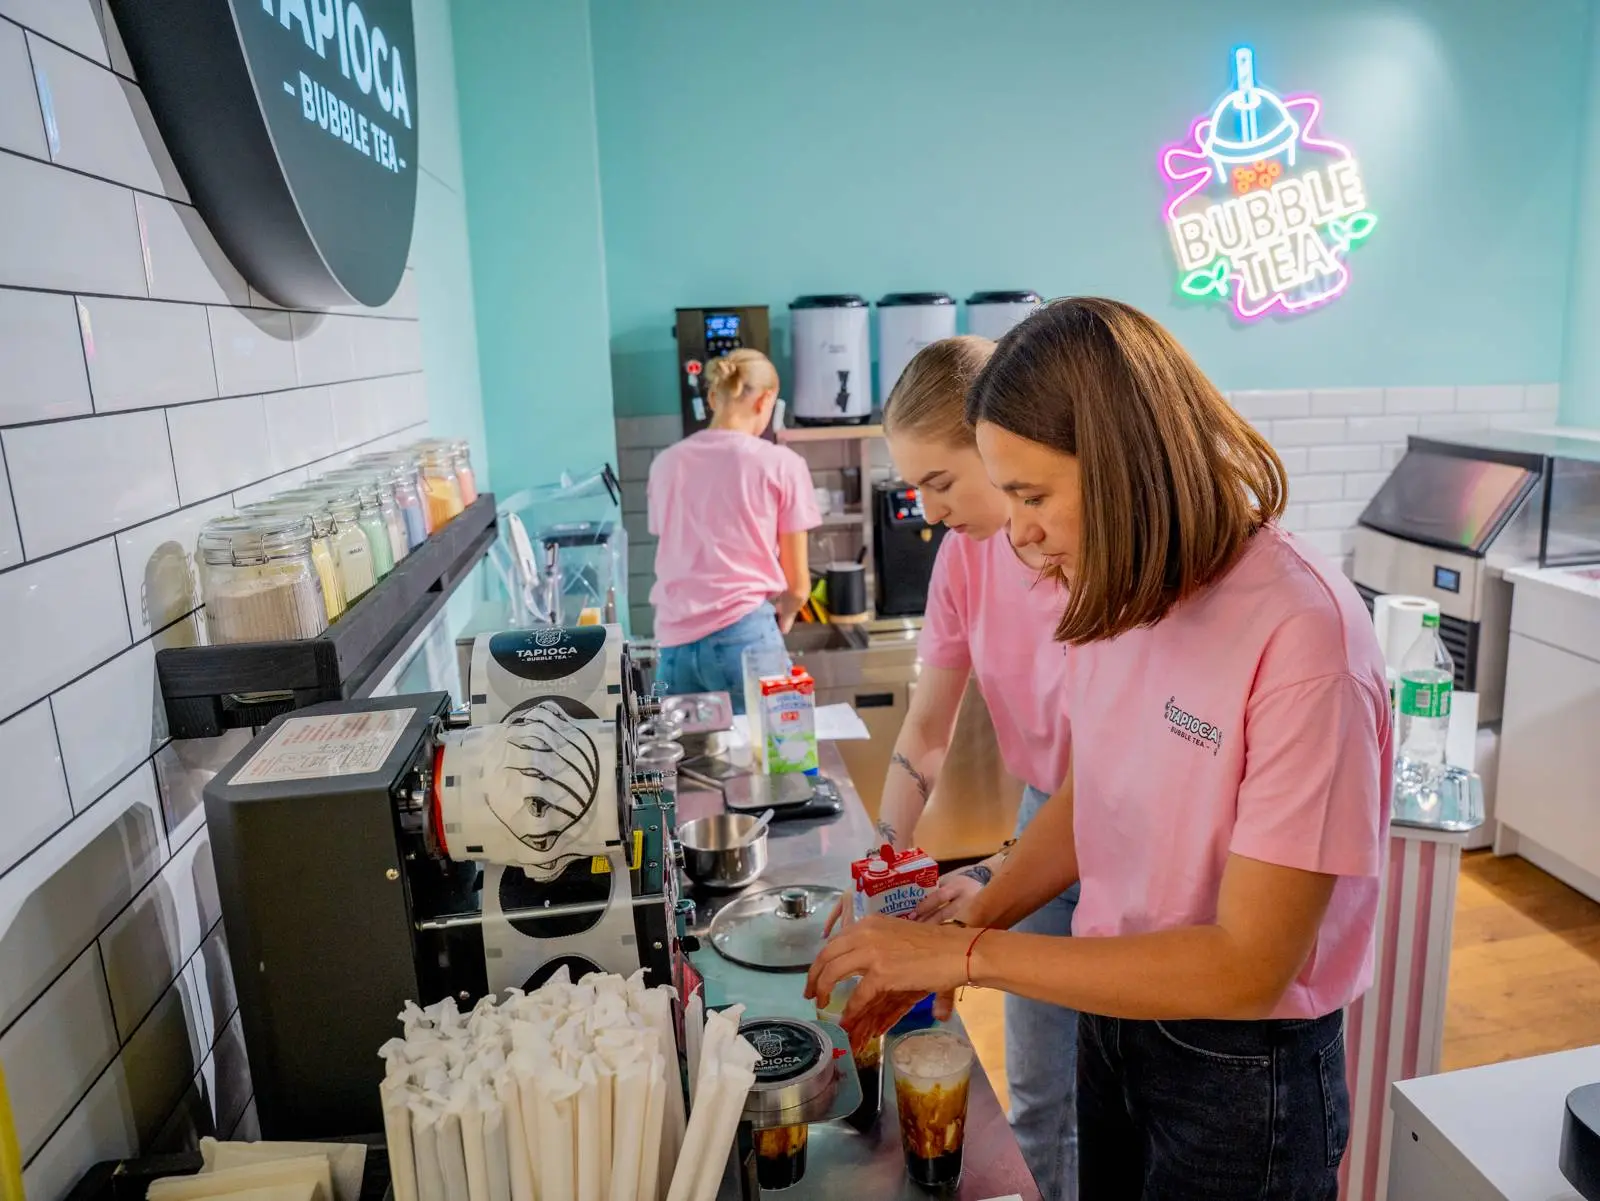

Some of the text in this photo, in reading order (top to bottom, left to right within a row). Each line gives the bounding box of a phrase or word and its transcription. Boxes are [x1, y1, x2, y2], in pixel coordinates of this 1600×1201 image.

[262, 0, 411, 129] APIOCA
[300, 71, 399, 173] BUBBLE TEA
[1173, 159, 1367, 271] BUBBLE
[1231, 226, 1340, 301] TEA
[515, 646, 578, 657] TAPIOCA
[1169, 705, 1218, 744] TAPIOCA
[1170, 726, 1205, 748] BUBBLE TEA
[884, 886, 925, 903] mleko
[755, 1056, 802, 1067] APIOCA
